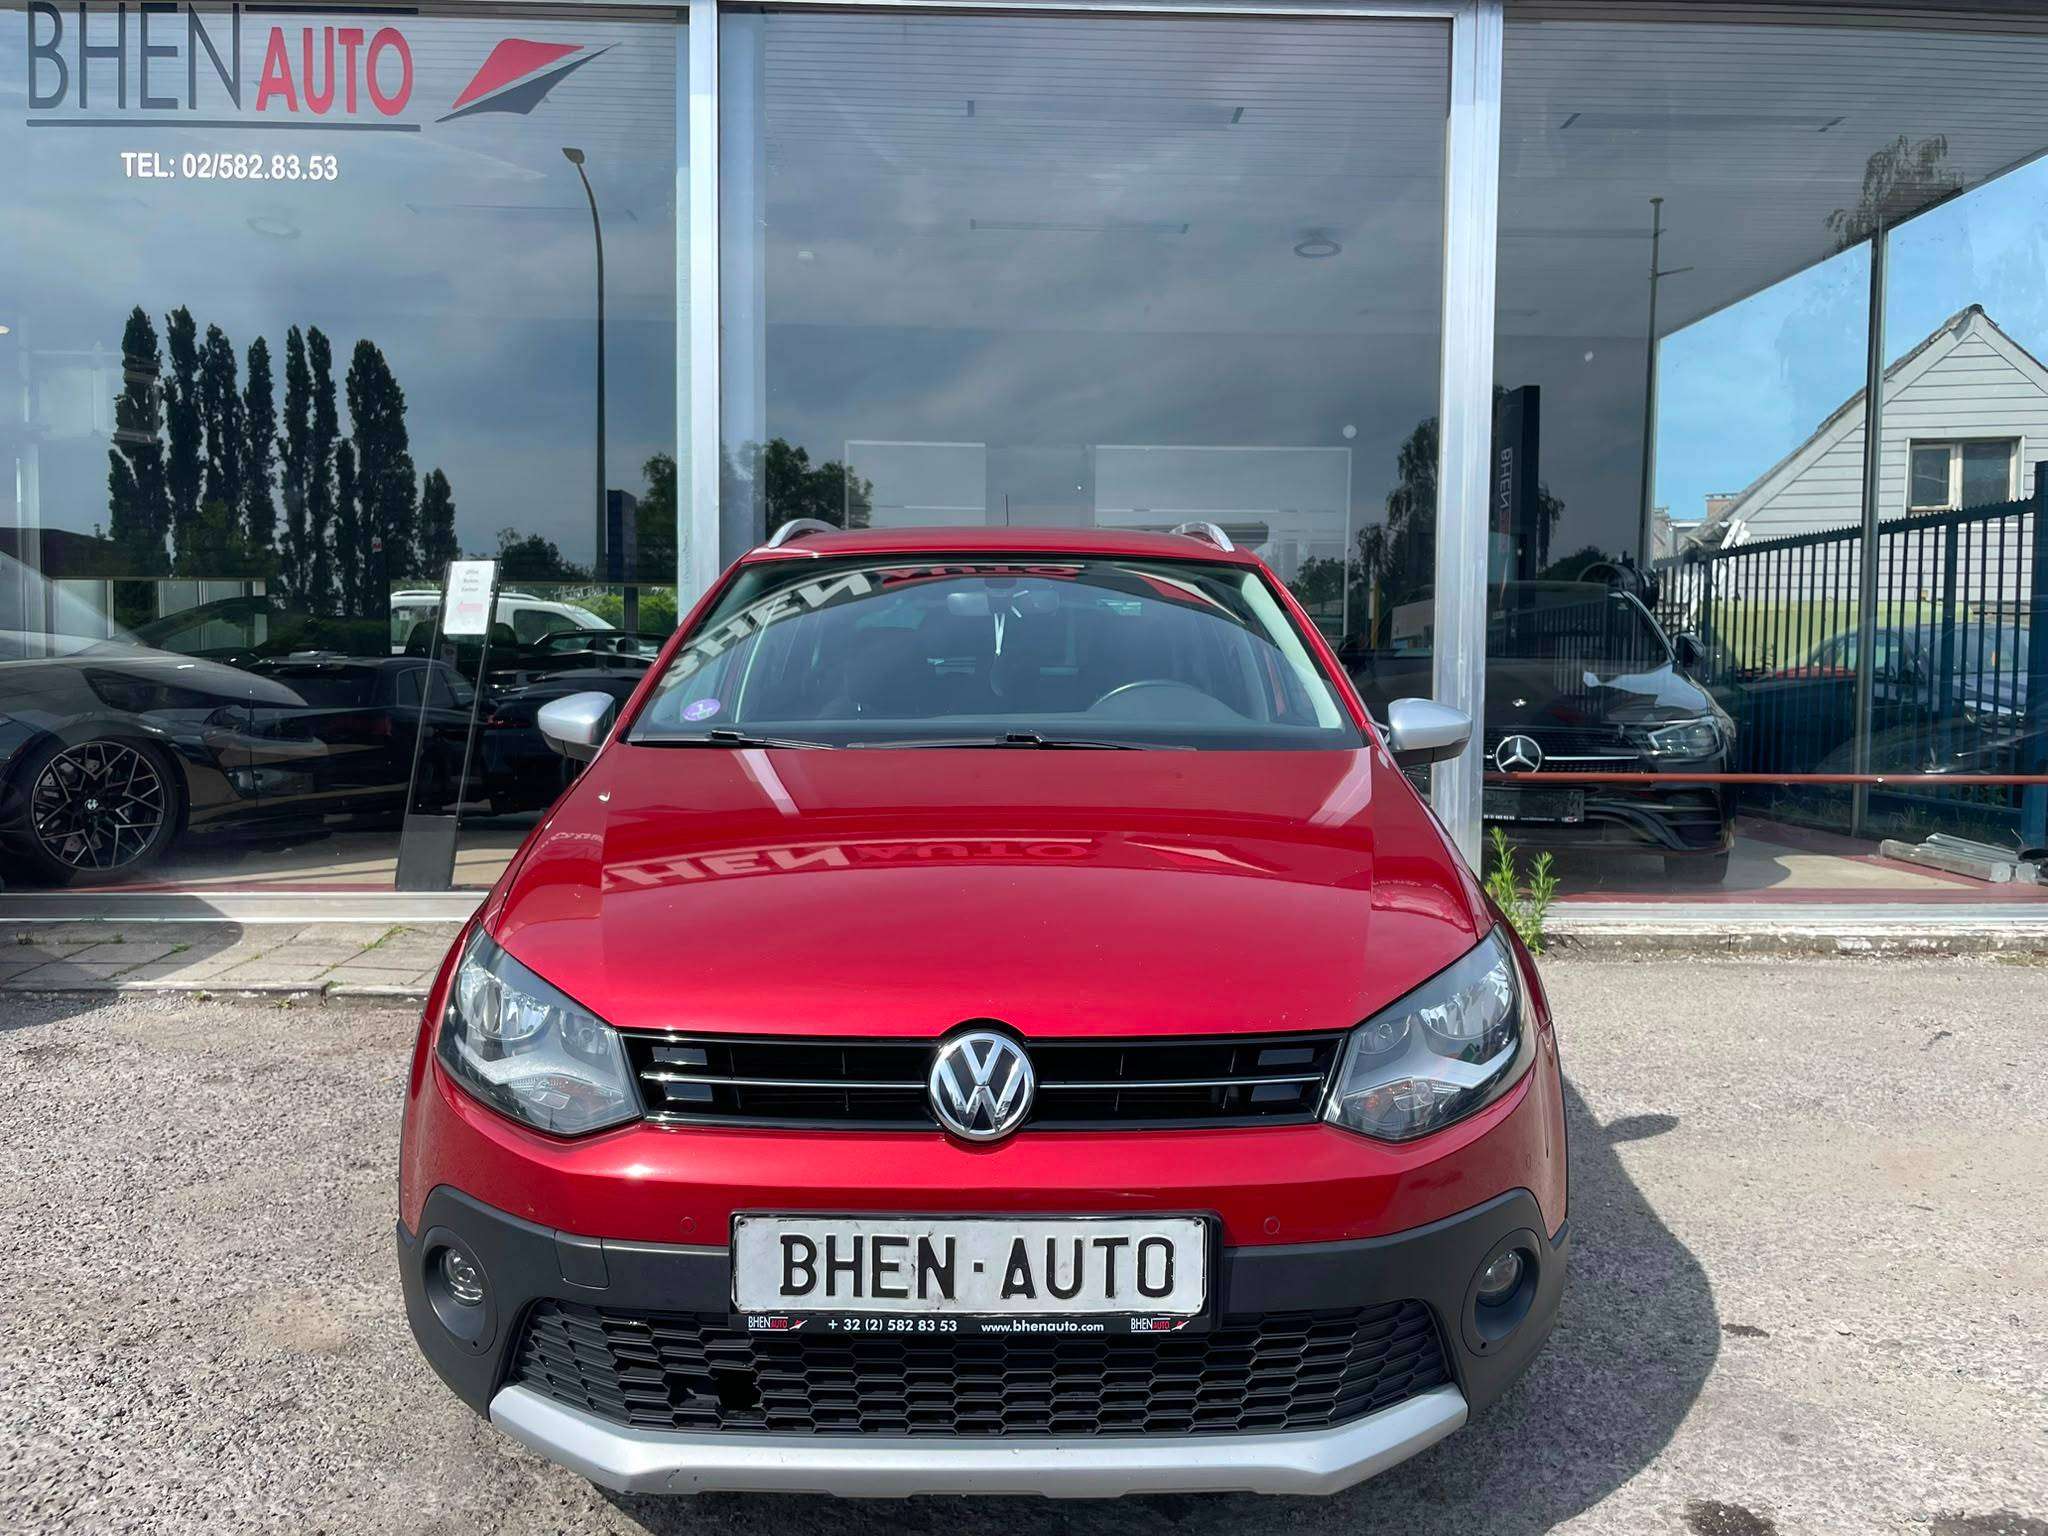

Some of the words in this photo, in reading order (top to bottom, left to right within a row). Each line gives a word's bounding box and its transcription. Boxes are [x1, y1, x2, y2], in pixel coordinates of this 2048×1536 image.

[120, 152, 175, 179] TEL:
[181, 152, 339, 181] 02/582.83.53
[779, 1233, 956, 1300] BHEN
[1000, 1235, 1175, 1300] AUTO
[843, 1319, 860, 1331] 32
[865, 1319, 883, 1332] (2)
[888, 1319, 914, 1332] 582
[918, 1319, 935, 1332] 83
[939, 1320, 957, 1332] 53
[981, 1320, 1104, 1332] www.bhenauto.com
